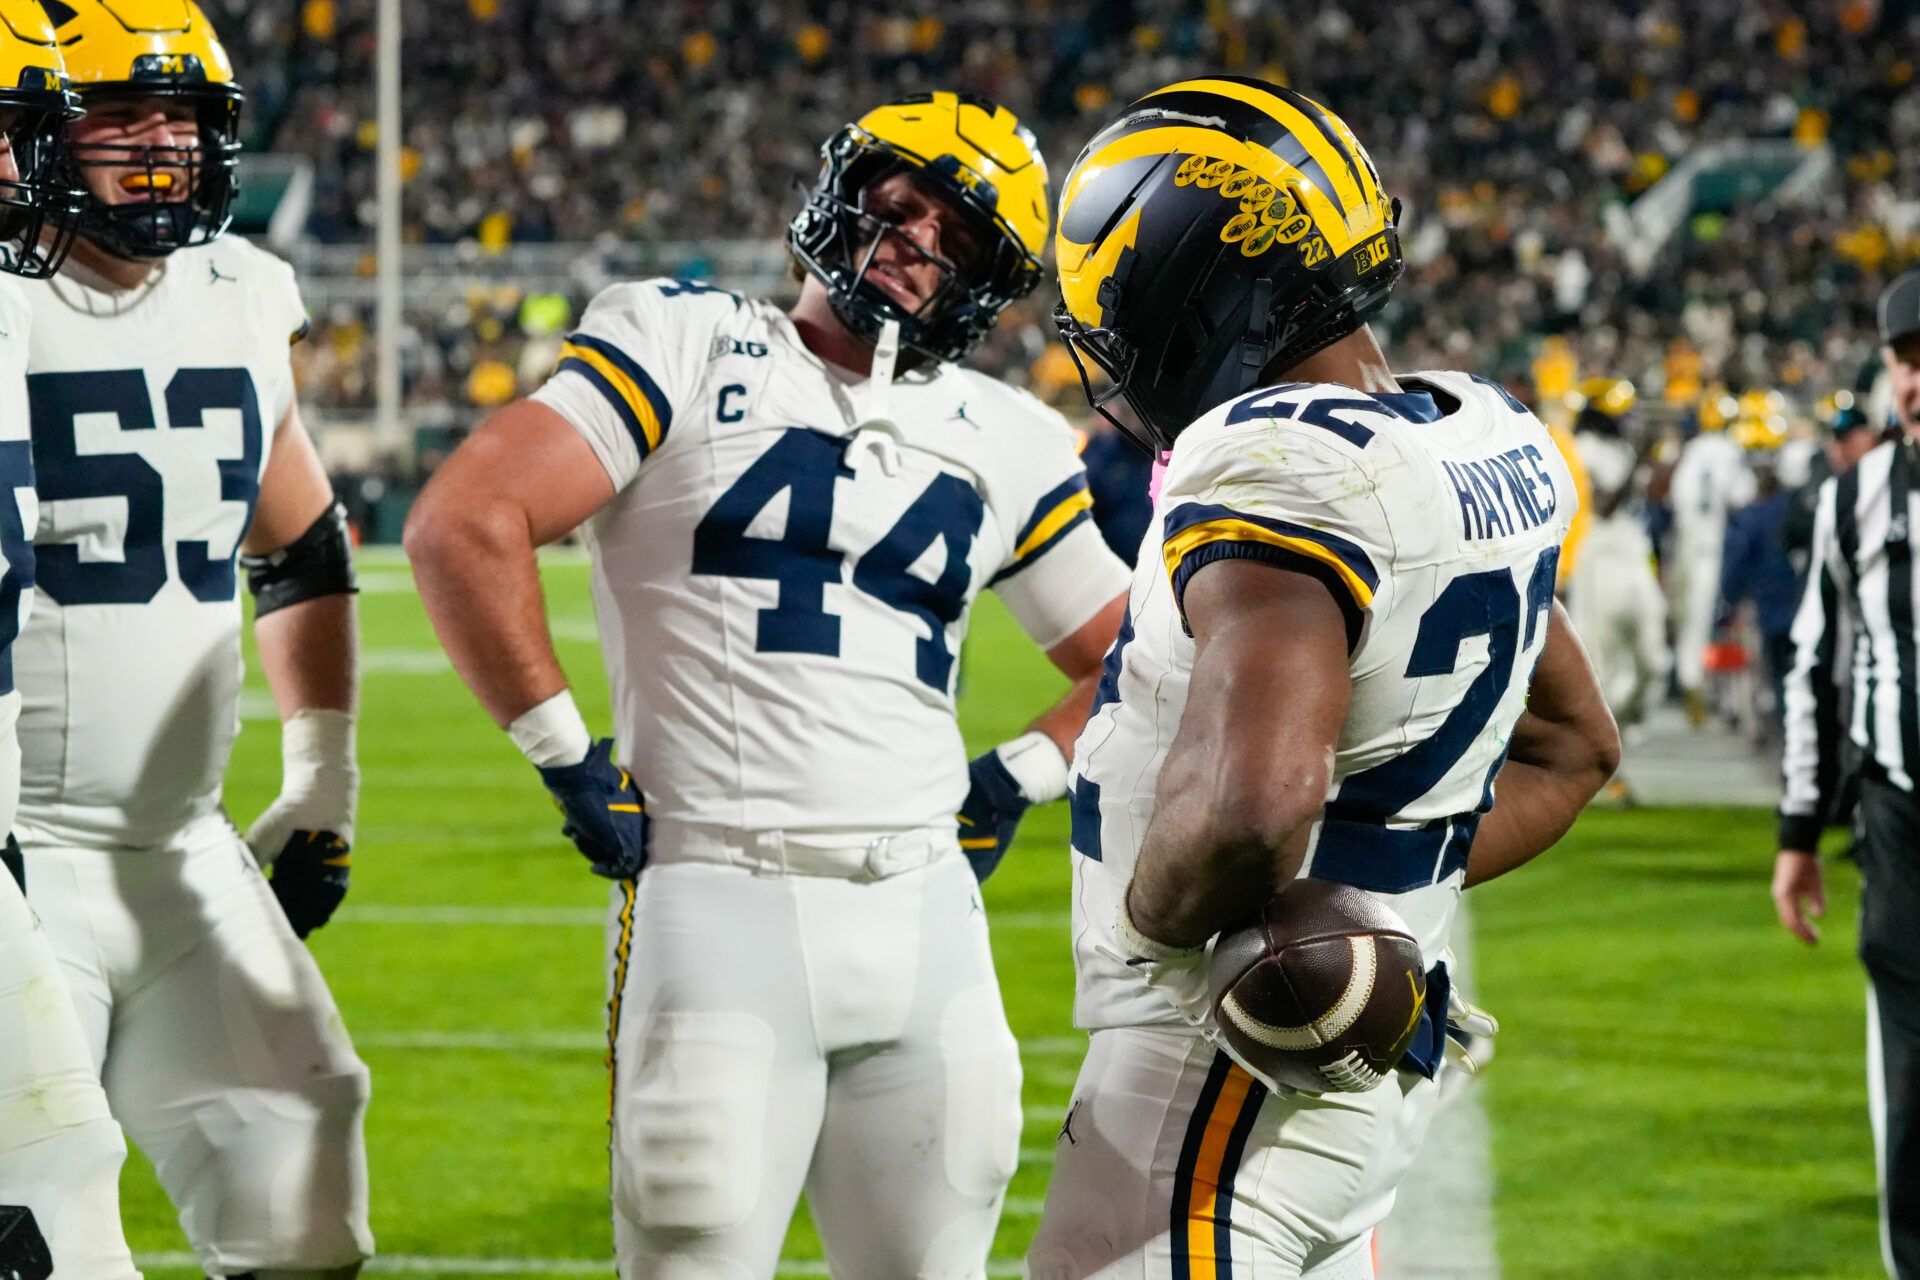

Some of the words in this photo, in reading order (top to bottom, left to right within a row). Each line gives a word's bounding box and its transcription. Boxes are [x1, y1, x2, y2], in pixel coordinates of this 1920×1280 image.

[44, 71, 61, 91] M
[161, 56, 185, 73] M
[1280, 218, 1306, 239] TED
[1299, 236, 1329, 268] 22
[716, 384, 746, 424] C
[26, 367, 263, 606] 53
[1443, 444, 1555, 540] HAYNES
[691, 427, 984, 696] 44
